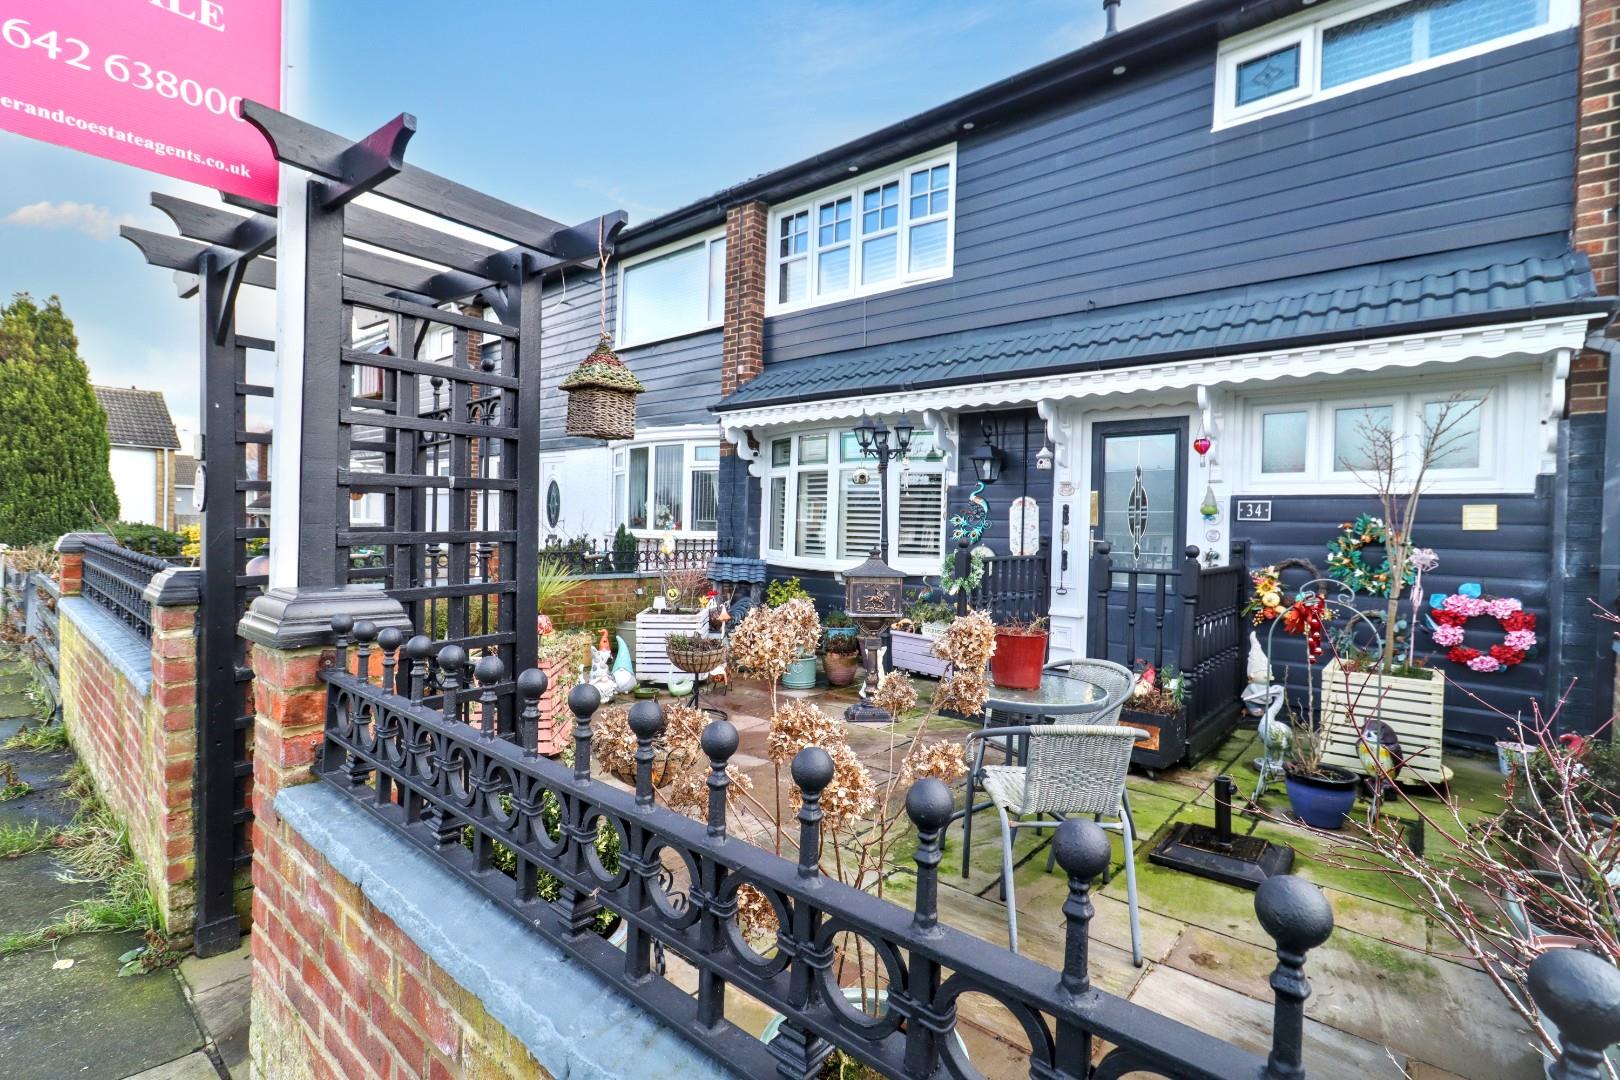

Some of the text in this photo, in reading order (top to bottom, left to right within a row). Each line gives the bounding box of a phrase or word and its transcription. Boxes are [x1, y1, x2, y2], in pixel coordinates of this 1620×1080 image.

[148, 0, 225, 32] LE
[0, 96, 251, 178] erandcoestateagents.co.uk
[1246, 503, 1262, 518] 34
